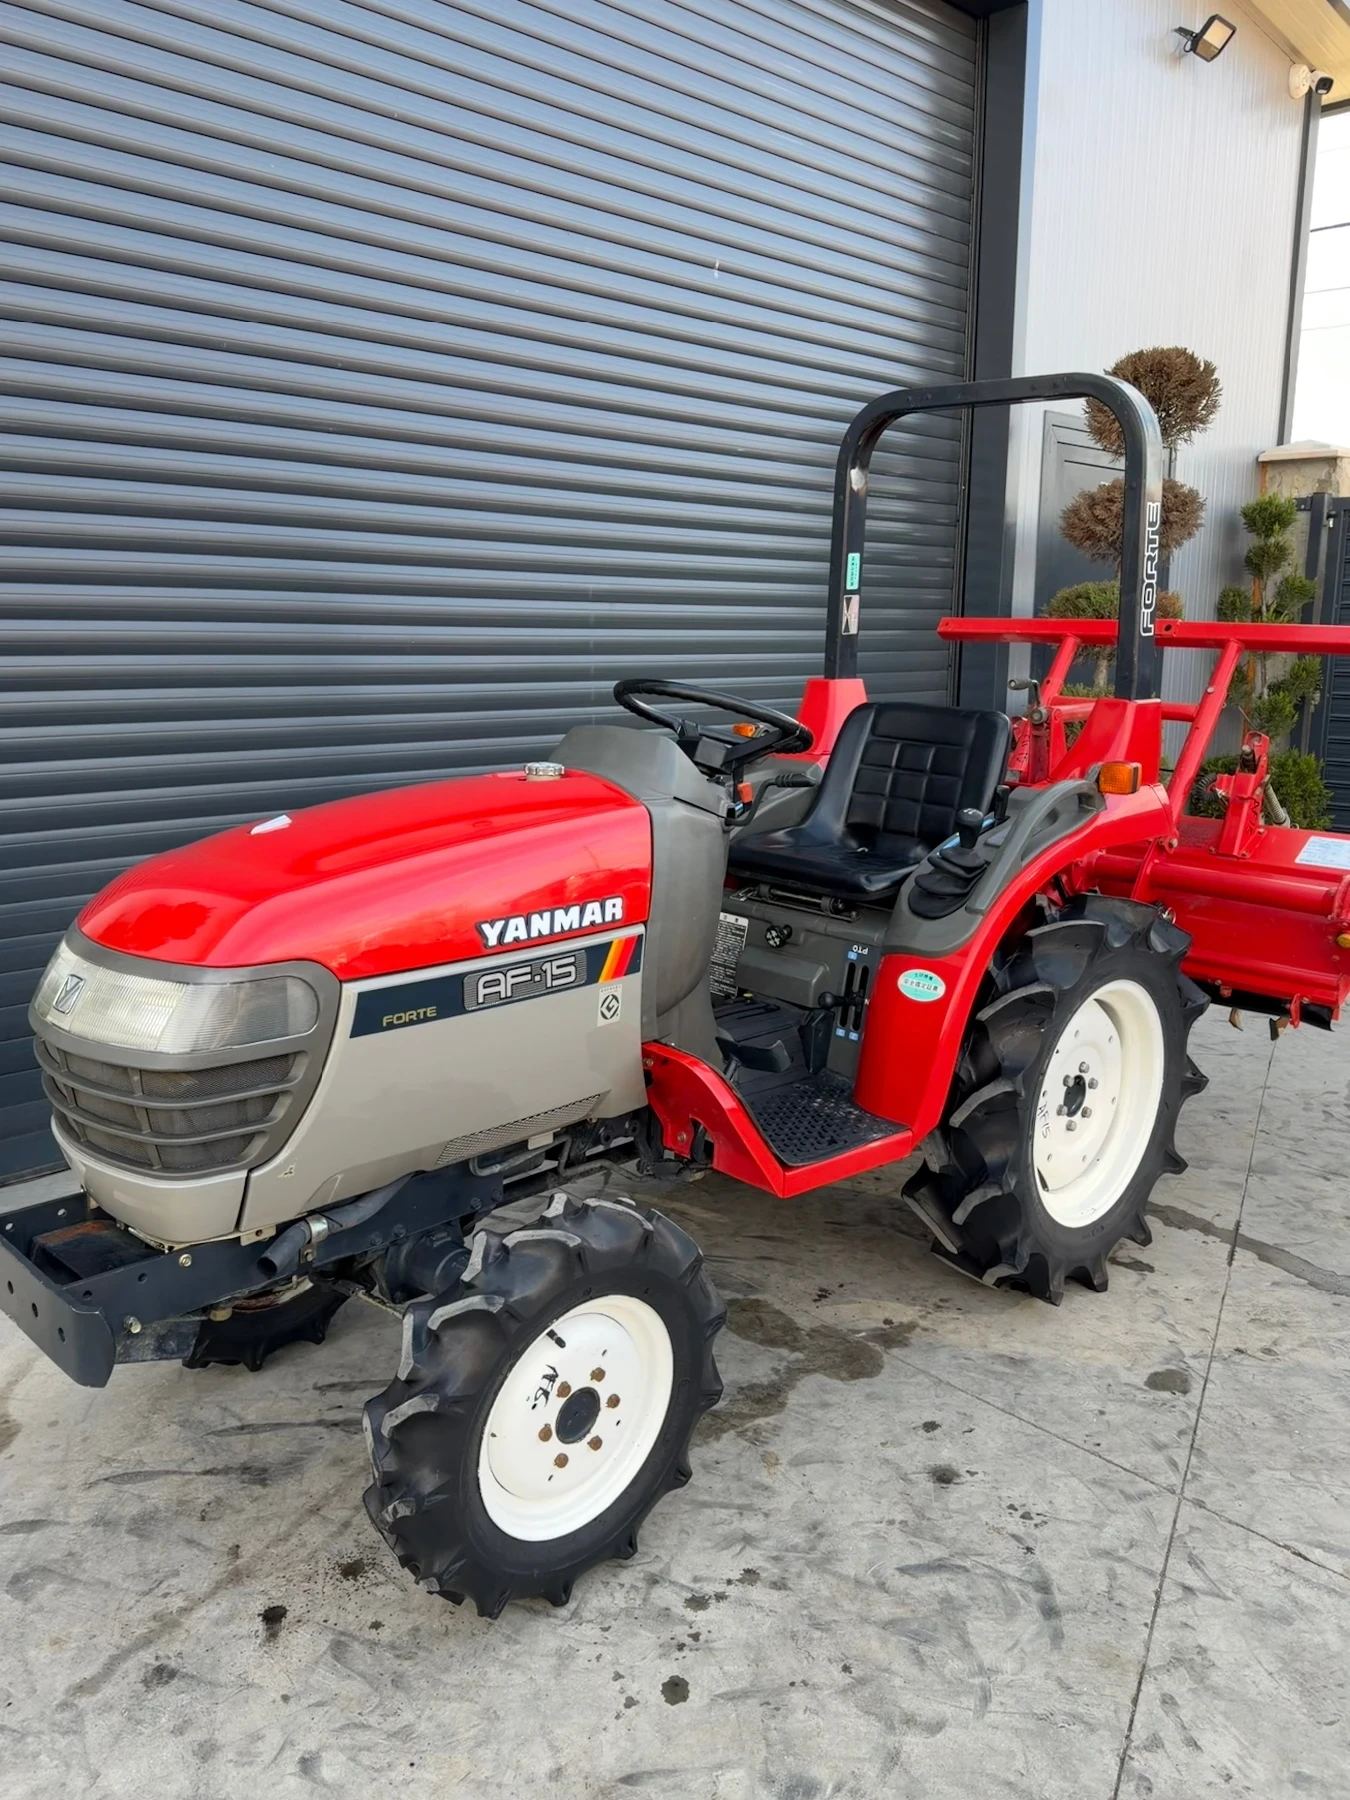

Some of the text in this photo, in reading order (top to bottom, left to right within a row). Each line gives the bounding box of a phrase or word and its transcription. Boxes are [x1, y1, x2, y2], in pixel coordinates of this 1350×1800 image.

[1140, 502, 1161, 637] FORTE
[478, 896, 624, 948] YANMAR
[852, 944, 869, 955] PTO
[382, 1005, 437, 1027] FORTE
